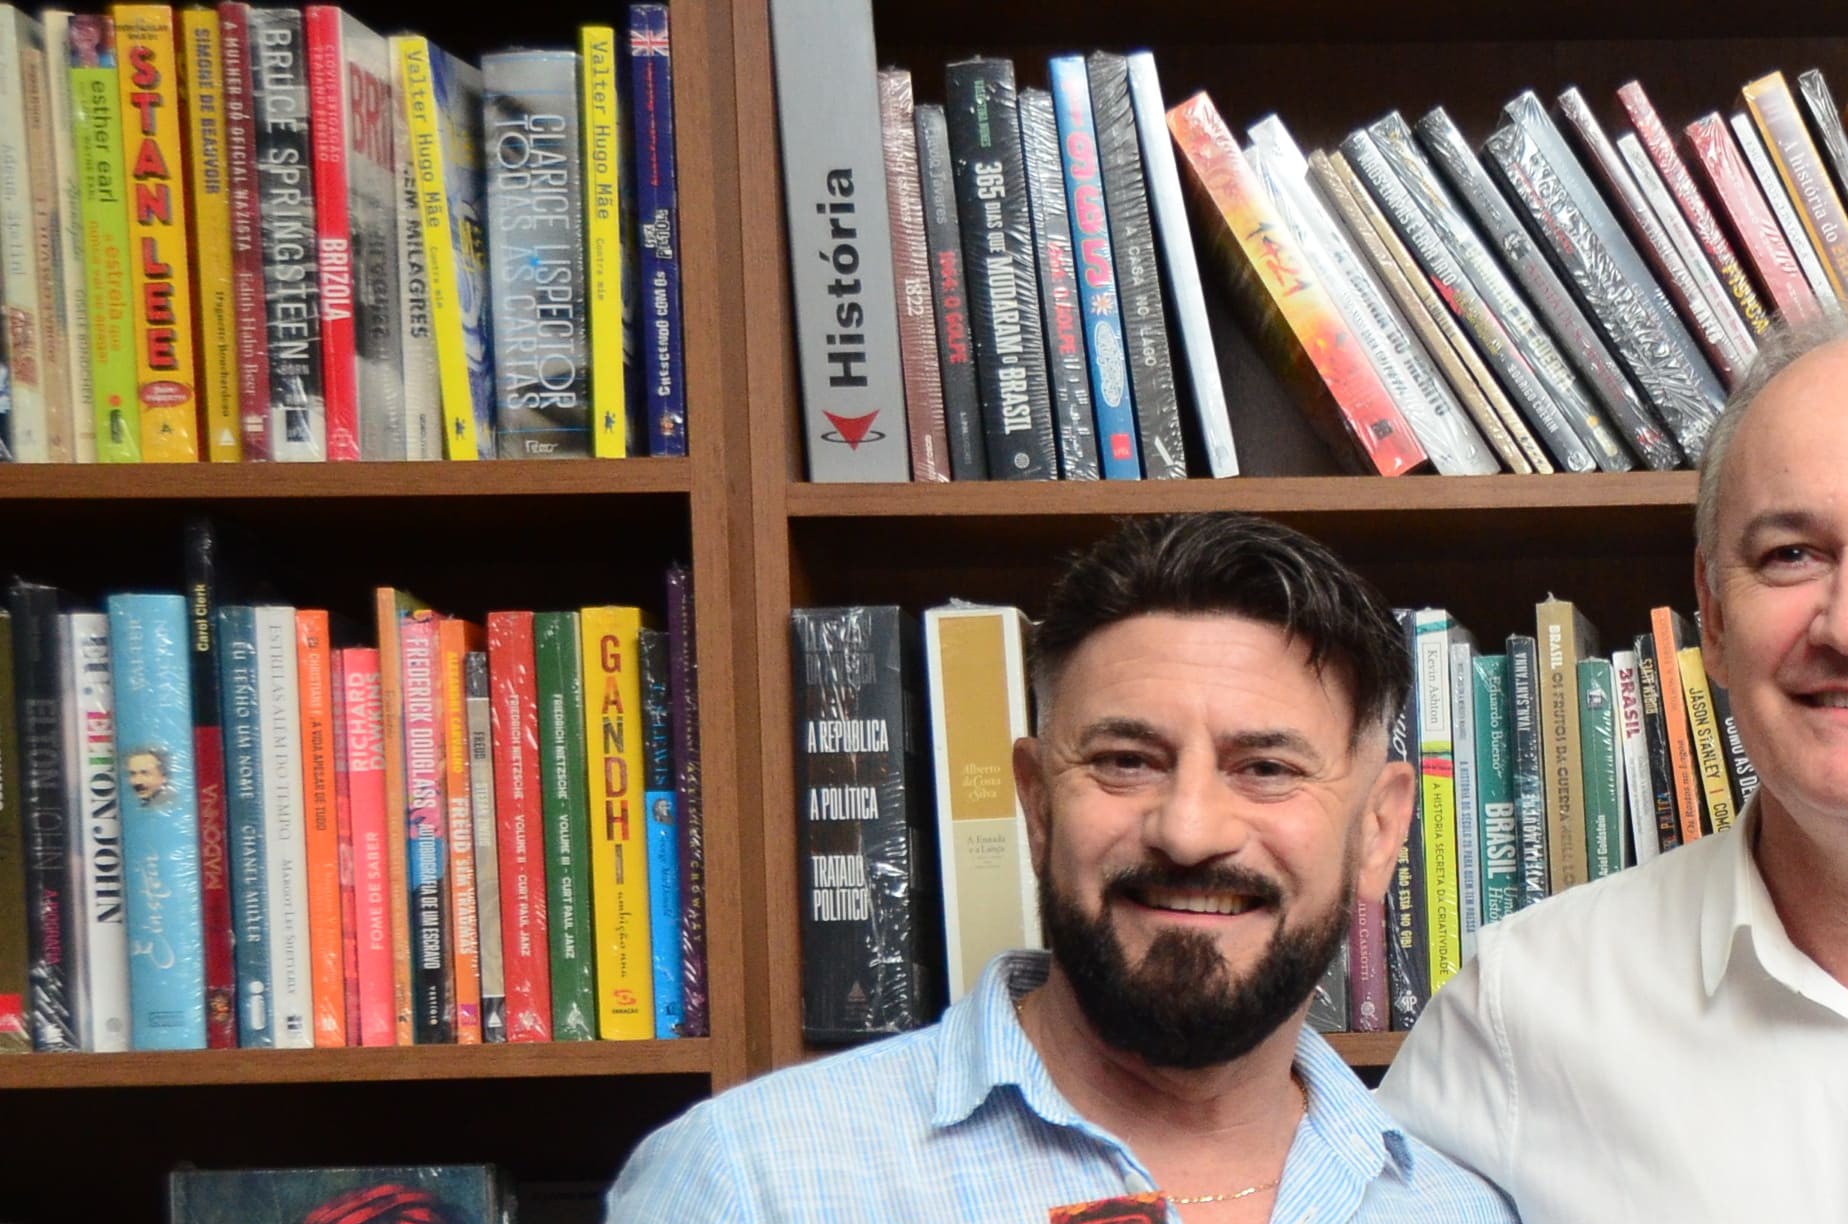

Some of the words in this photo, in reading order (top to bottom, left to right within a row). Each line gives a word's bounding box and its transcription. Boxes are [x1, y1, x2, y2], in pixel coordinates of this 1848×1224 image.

[225, 38, 241, 95] MULHER
[261, 29, 297, 133] BRUCE
[407, 50, 428, 123] Valter
[590, 41, 608, 114] Valter
[92, 80, 114, 150] esther
[129, 46, 171, 226] STAN
[97, 160, 117, 203] earl
[229, 127, 245, 182] OFICIAL
[416, 134, 435, 184] Hugo
[495, 114, 533, 231] TODAS
[529, 113, 571, 231] CLARICE
[595, 125, 611, 175] Hugo
[975, 162, 1006, 199] 365
[234, 189, 251, 251] NAZISTA
[423, 190, 441, 228] Mãe
[597, 183, 613, 220] Mãe
[986, 203, 1002, 230] DIAS
[1785, 151, 1833, 220] história
[1820, 219, 1843, 244] do
[268, 148, 310, 361] SPRINGSTEEN
[323, 238, 351, 322] BRIZOLA
[816, 168, 868, 388] História
[140, 237, 179, 370] LEE
[537, 243, 578, 409] LISPECTOR
[905, 278, 924, 316] 1822
[987, 256, 1023, 353] MUDARAM
[501, 294, 541, 410] CARTAS
[945, 312, 968, 364] GOLPE
[998, 367, 1033, 434] BRASIL
[1425, 649, 1439, 682] Kevin
[1547, 624, 1563, 668] BRASIL
[407, 638, 433, 721] FREDERICK
[1426, 684, 1440, 724] Ashton
[1616, 667, 1642, 740] BRASIL
[1688, 685, 1711, 727] JASON
[348, 672, 369, 771] RICHARD
[808, 721, 816, 753] A
[1696, 727, 1720, 779] STANLEY
[409, 727, 435, 808] DOUGLASS
[599, 634, 630, 885] GANDHI
[1431, 782, 1443, 791] A
[553, 694, 567, 743] FRIEDRICH
[561, 932, 574, 958] JANZ
[810, 789, 819, 820] A
[201, 784, 223, 890] MADONNA
[363, 831, 382, 878] SABER
[1433, 842, 1446, 886] SECRETA
[1484, 801, 1516, 879] BRASIL
[90, 824, 124, 926] JOHN
[366, 881, 383, 901] DE
[812, 856, 864, 887] TRATADO
[814, 886, 868, 921] POLÍTICO
[367, 904, 385, 950] FOME
[1435, 906, 1449, 975] CRIATIVIDADE
